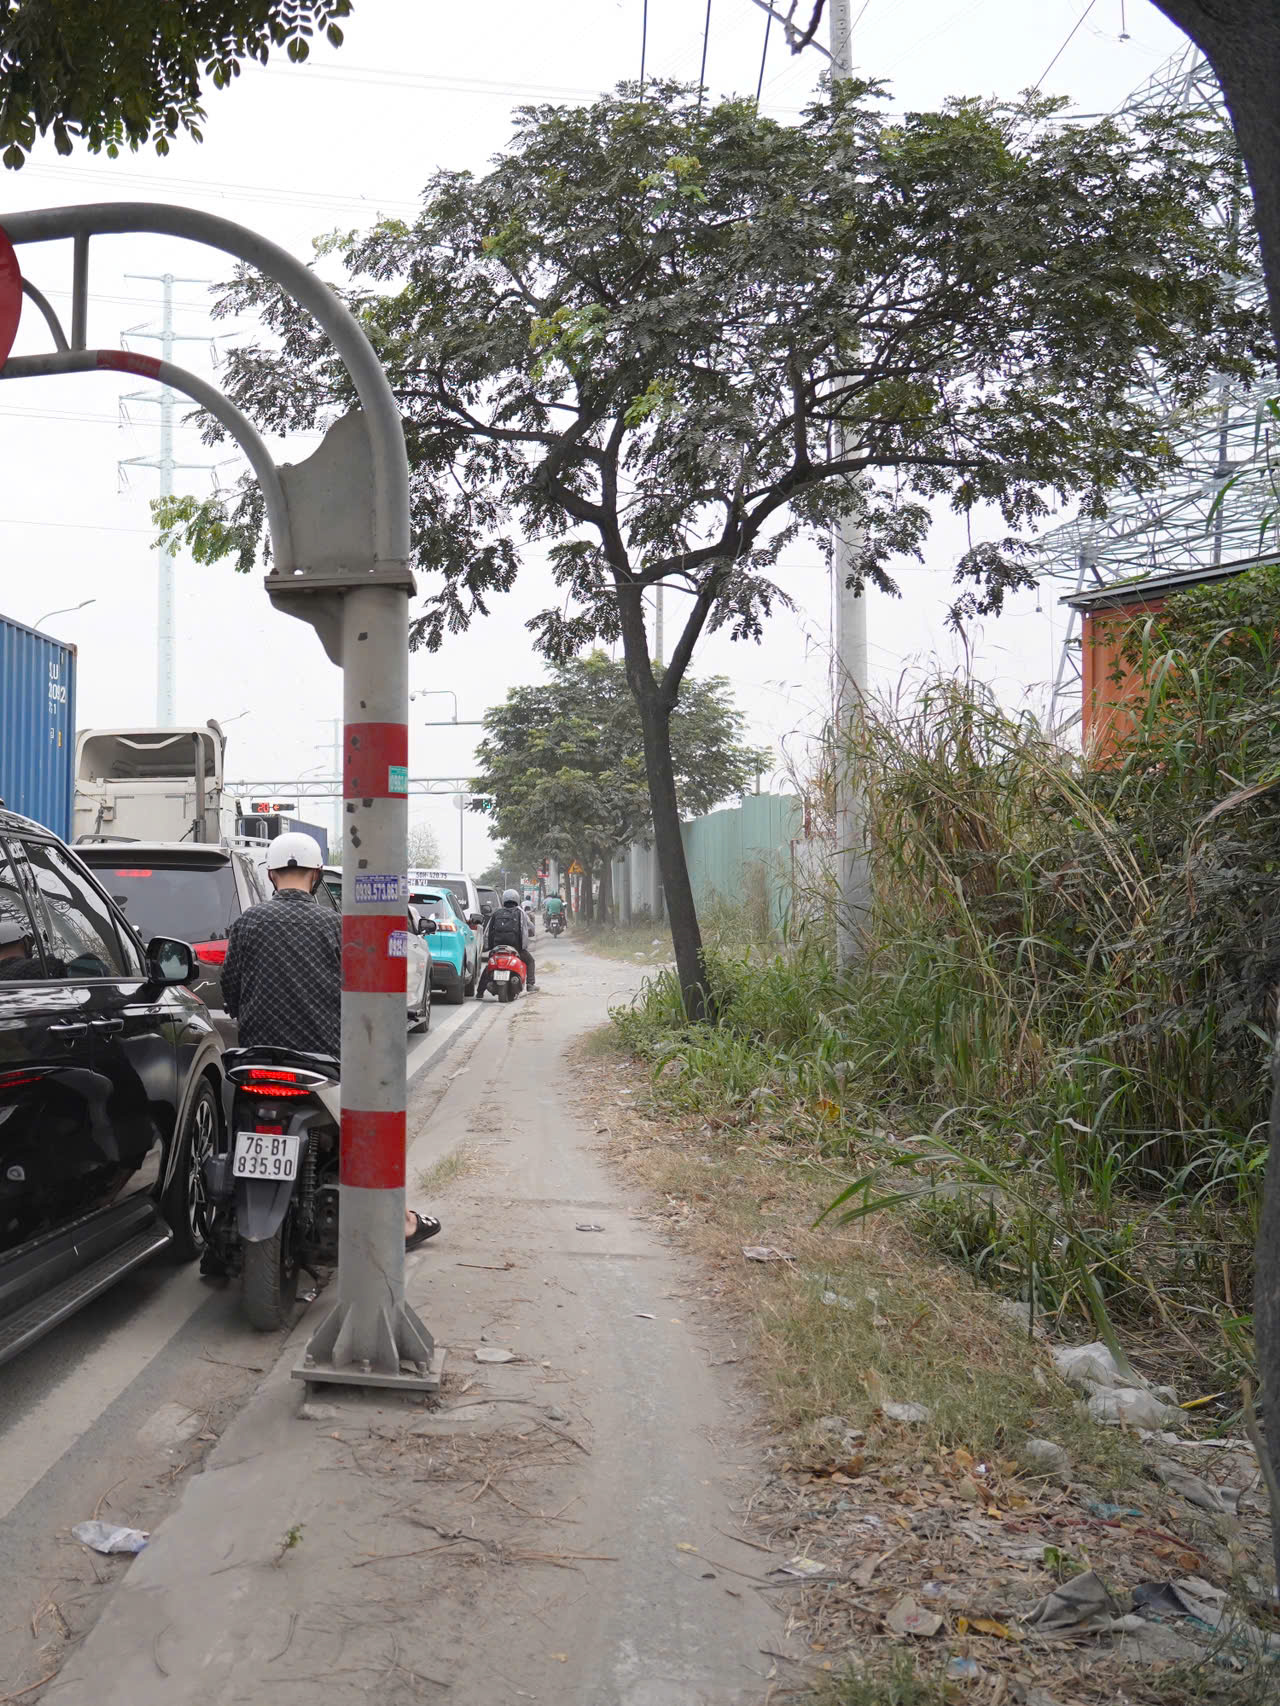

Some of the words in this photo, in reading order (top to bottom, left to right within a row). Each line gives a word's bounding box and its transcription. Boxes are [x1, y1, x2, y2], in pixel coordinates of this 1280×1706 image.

[257, 802, 269, 813] 20
[245, 1136, 287, 1157] 76-B1
[237, 1156, 293, 1177] 835.90
